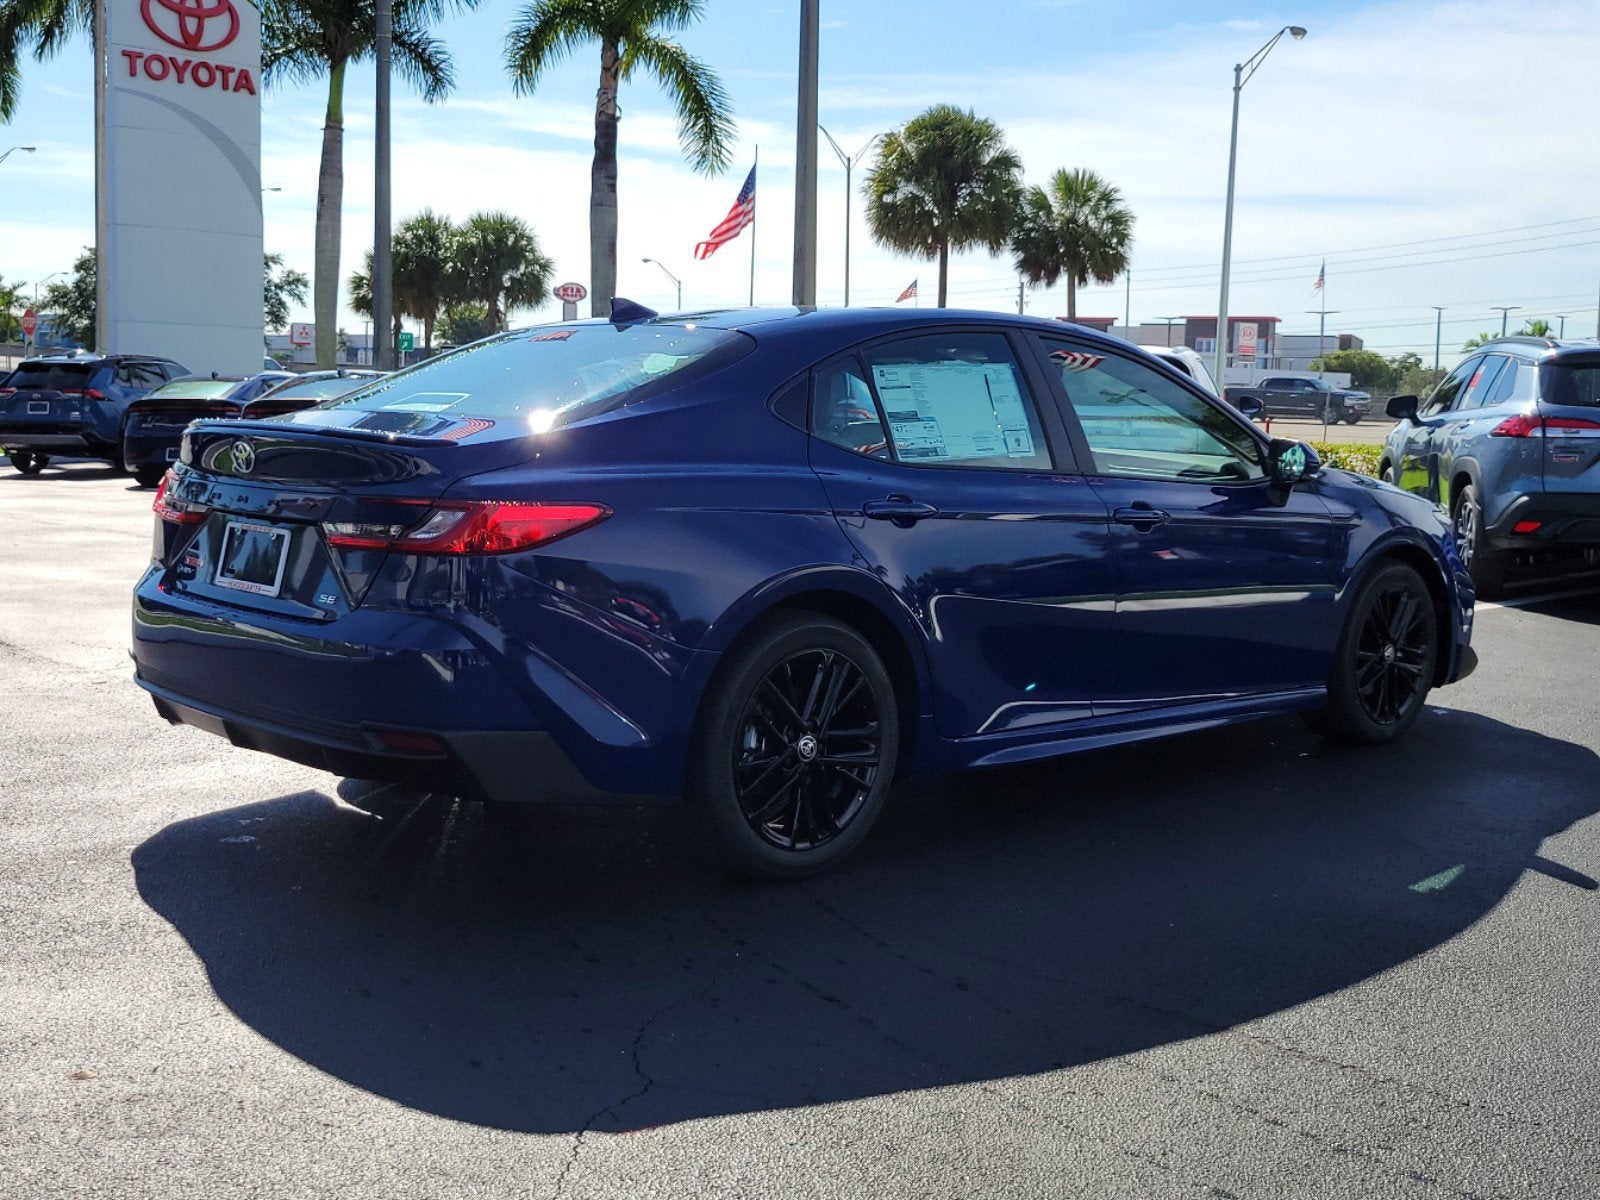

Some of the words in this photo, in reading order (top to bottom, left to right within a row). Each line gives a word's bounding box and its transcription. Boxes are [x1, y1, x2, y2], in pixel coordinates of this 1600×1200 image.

[122, 50, 256, 95] TOYOTA
[560, 286, 584, 298] KIA
[318, 593, 337, 604] SE
